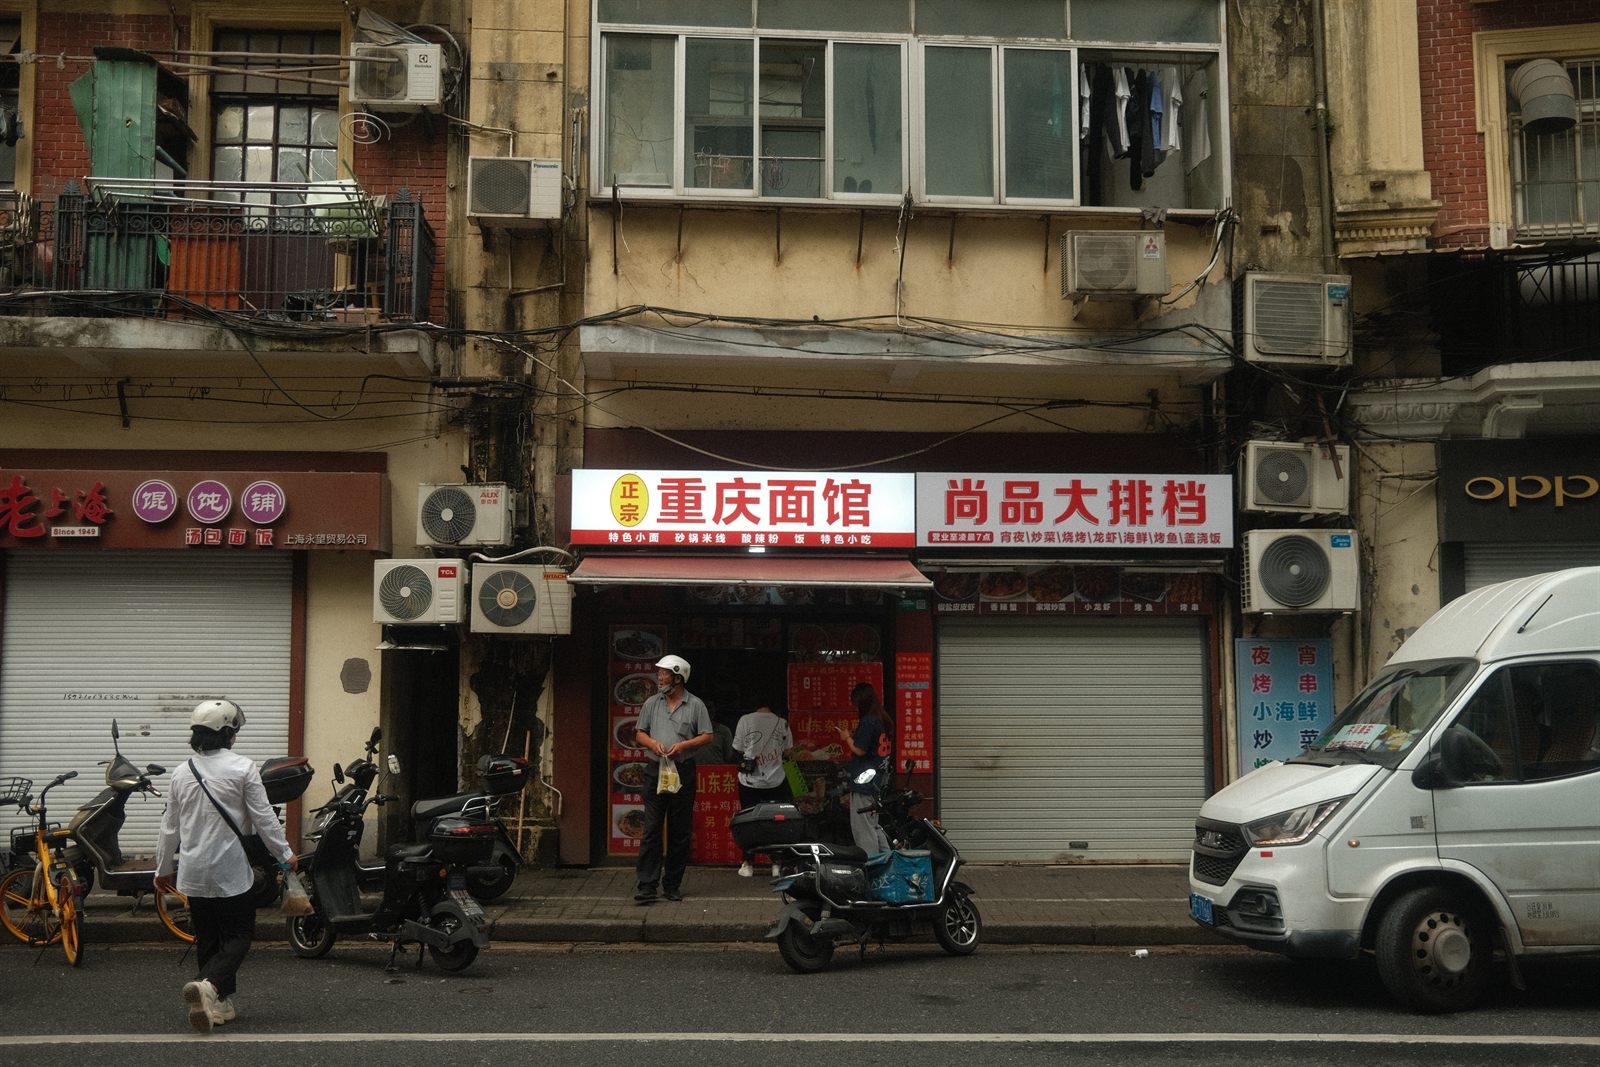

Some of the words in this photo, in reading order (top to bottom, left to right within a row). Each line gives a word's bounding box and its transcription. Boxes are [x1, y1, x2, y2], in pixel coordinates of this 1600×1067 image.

[0, 474, 114, 537] 老上海
[141, 490, 277, 513] 馄饨铺
[620, 481, 639, 521] 正宗
[656, 477, 872, 527] 重庆面馆
[945, 478, 1207, 527] 尚品大排档
[185, 528, 222, 545] 汤包
[228, 528, 247, 545] 面
[255, 528, 274, 546] 饭
[284, 533, 368, 546] 上海永望贸易公司
[608, 532, 660, 543] 特色小面
[675, 532, 726, 544] 砂锅米线
[741, 533, 779, 544] 酸辣粉
[794, 533, 805, 544] 饭
[820, 534, 872, 545] 特色小吃
[932, 533, 991, 542] 营业至凌晨7点
[1084, 603, 1111, 611] 小龙虾
[1252, 645, 1317, 665] 夜宵
[1252, 673, 1318, 693] 烤串
[1253, 701, 1318, 721] 小海鲜
[1253, 729, 1320, 750] 炒菜
